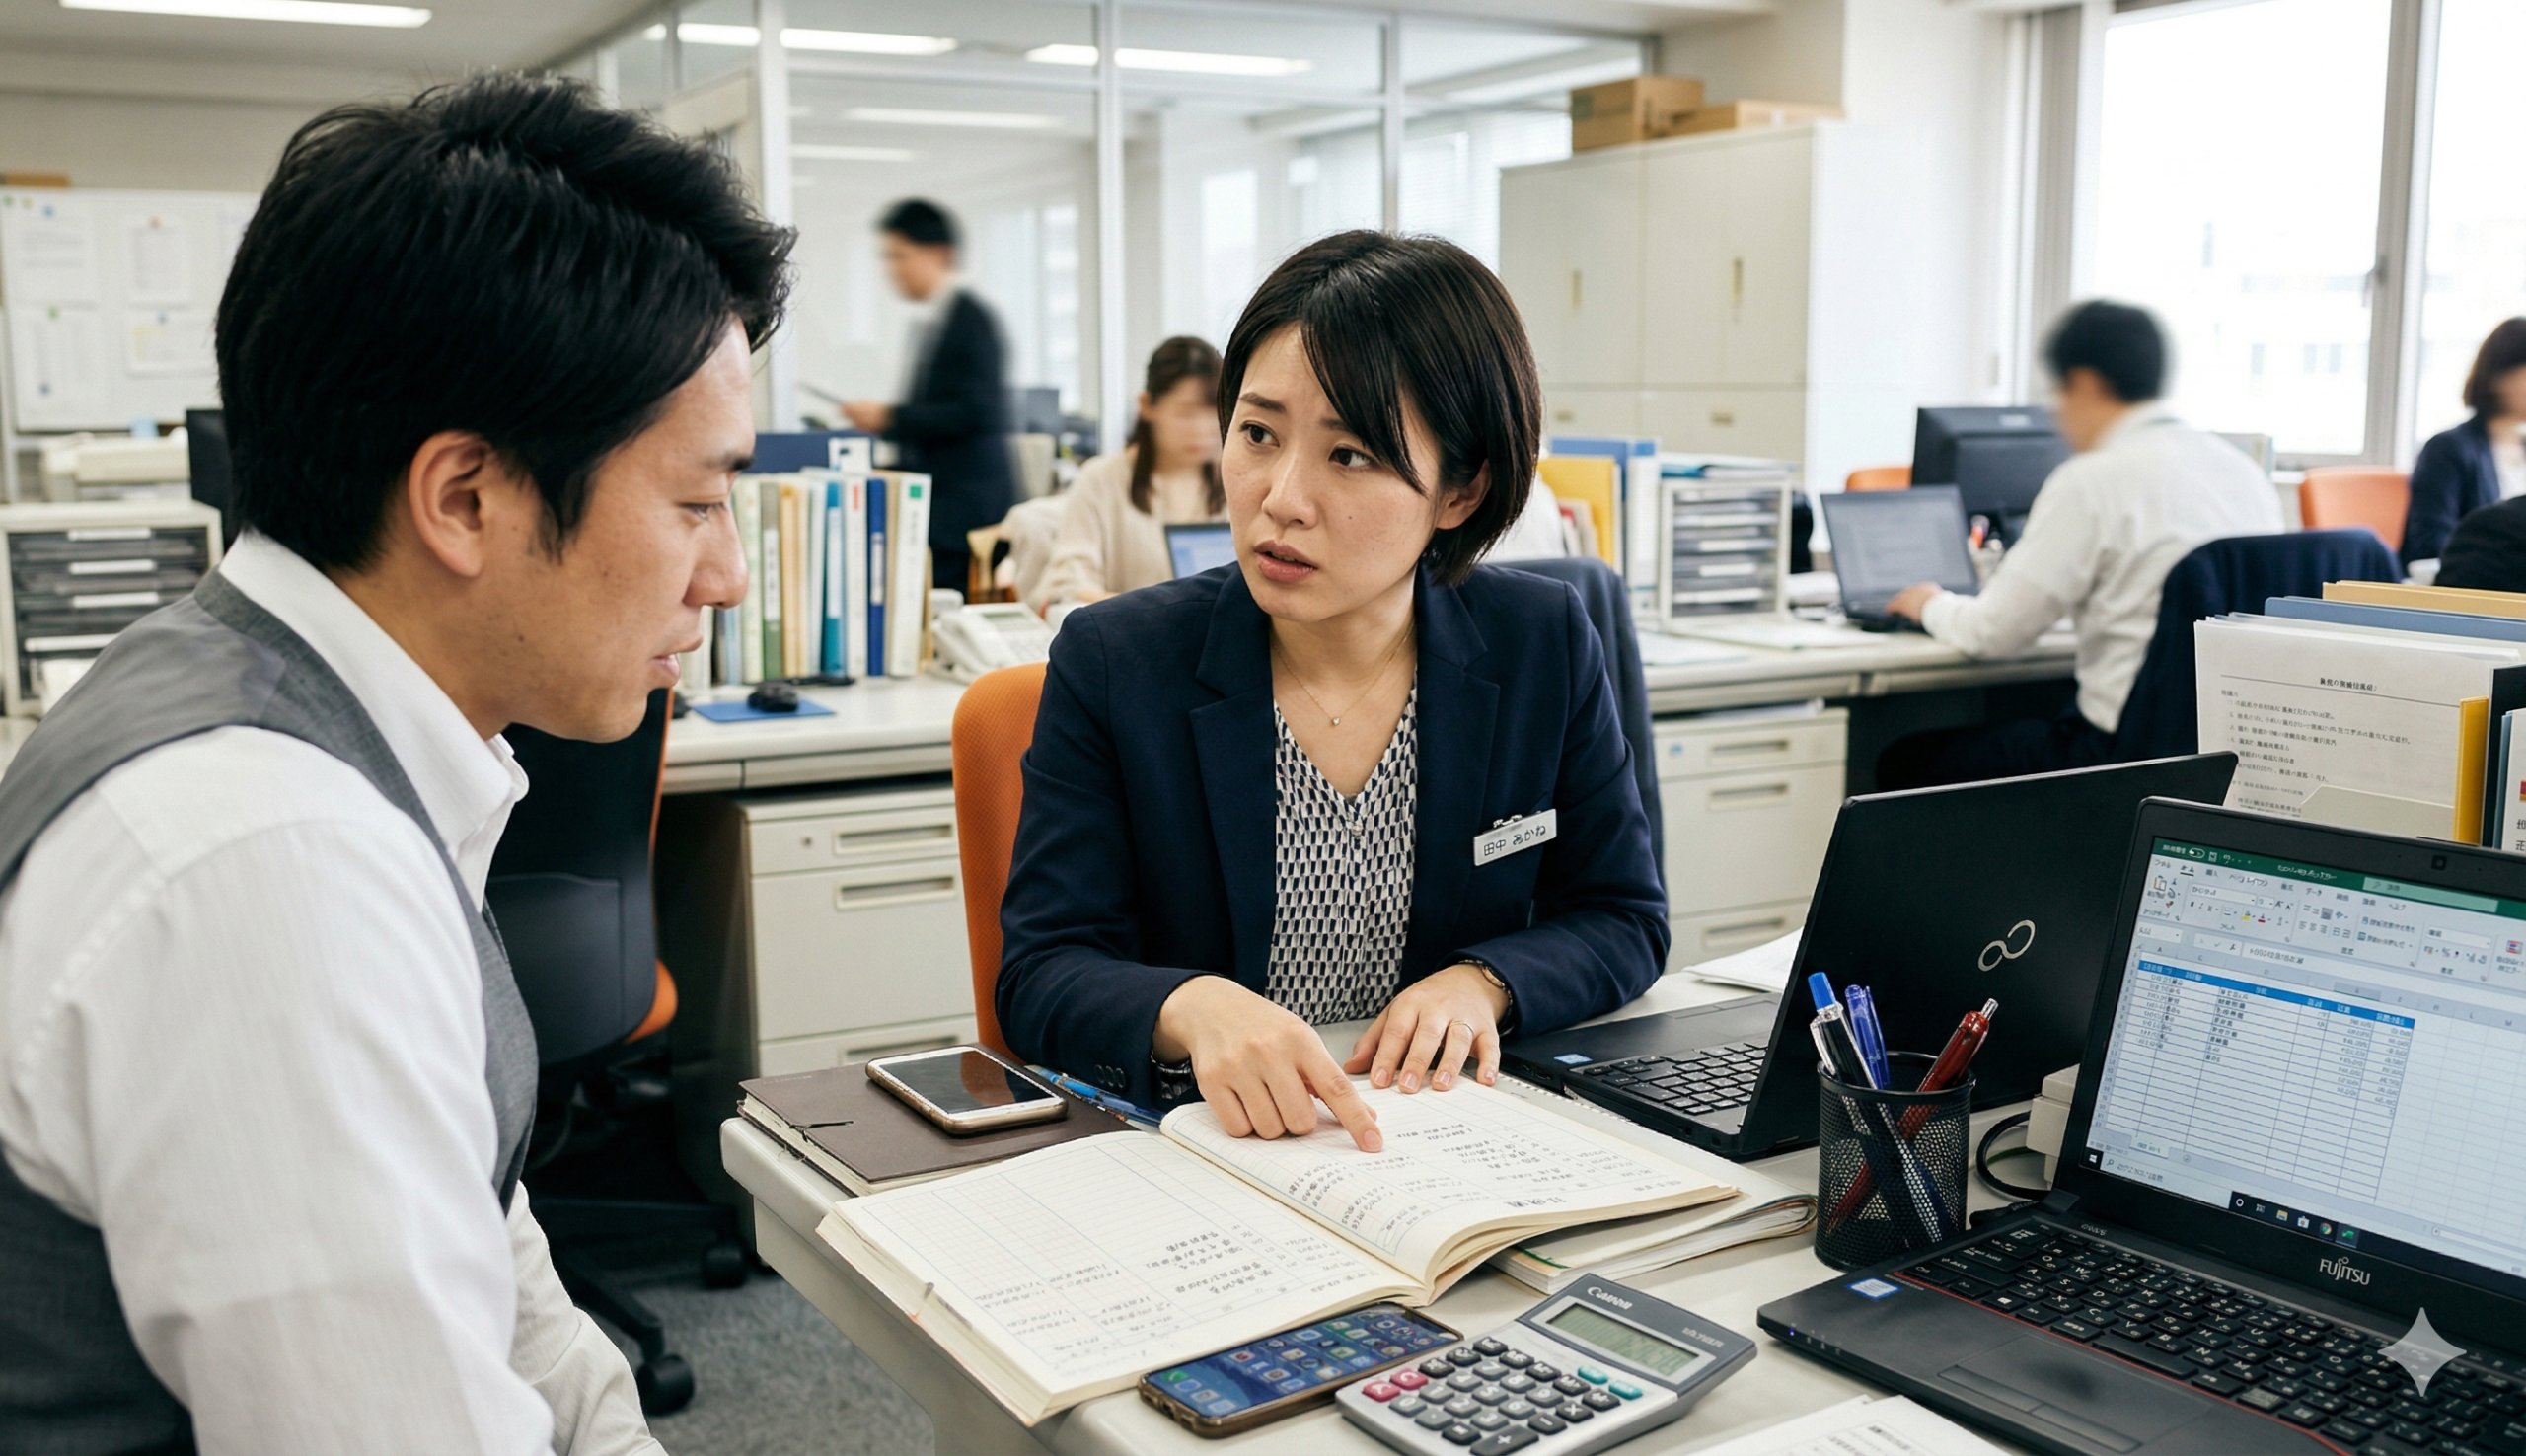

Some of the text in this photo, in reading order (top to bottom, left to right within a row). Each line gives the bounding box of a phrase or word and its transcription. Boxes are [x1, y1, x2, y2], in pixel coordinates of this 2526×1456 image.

[1483, 825, 1546, 856] 田中 あかね
[2319, 1257, 2371, 1286] FUJITSU
